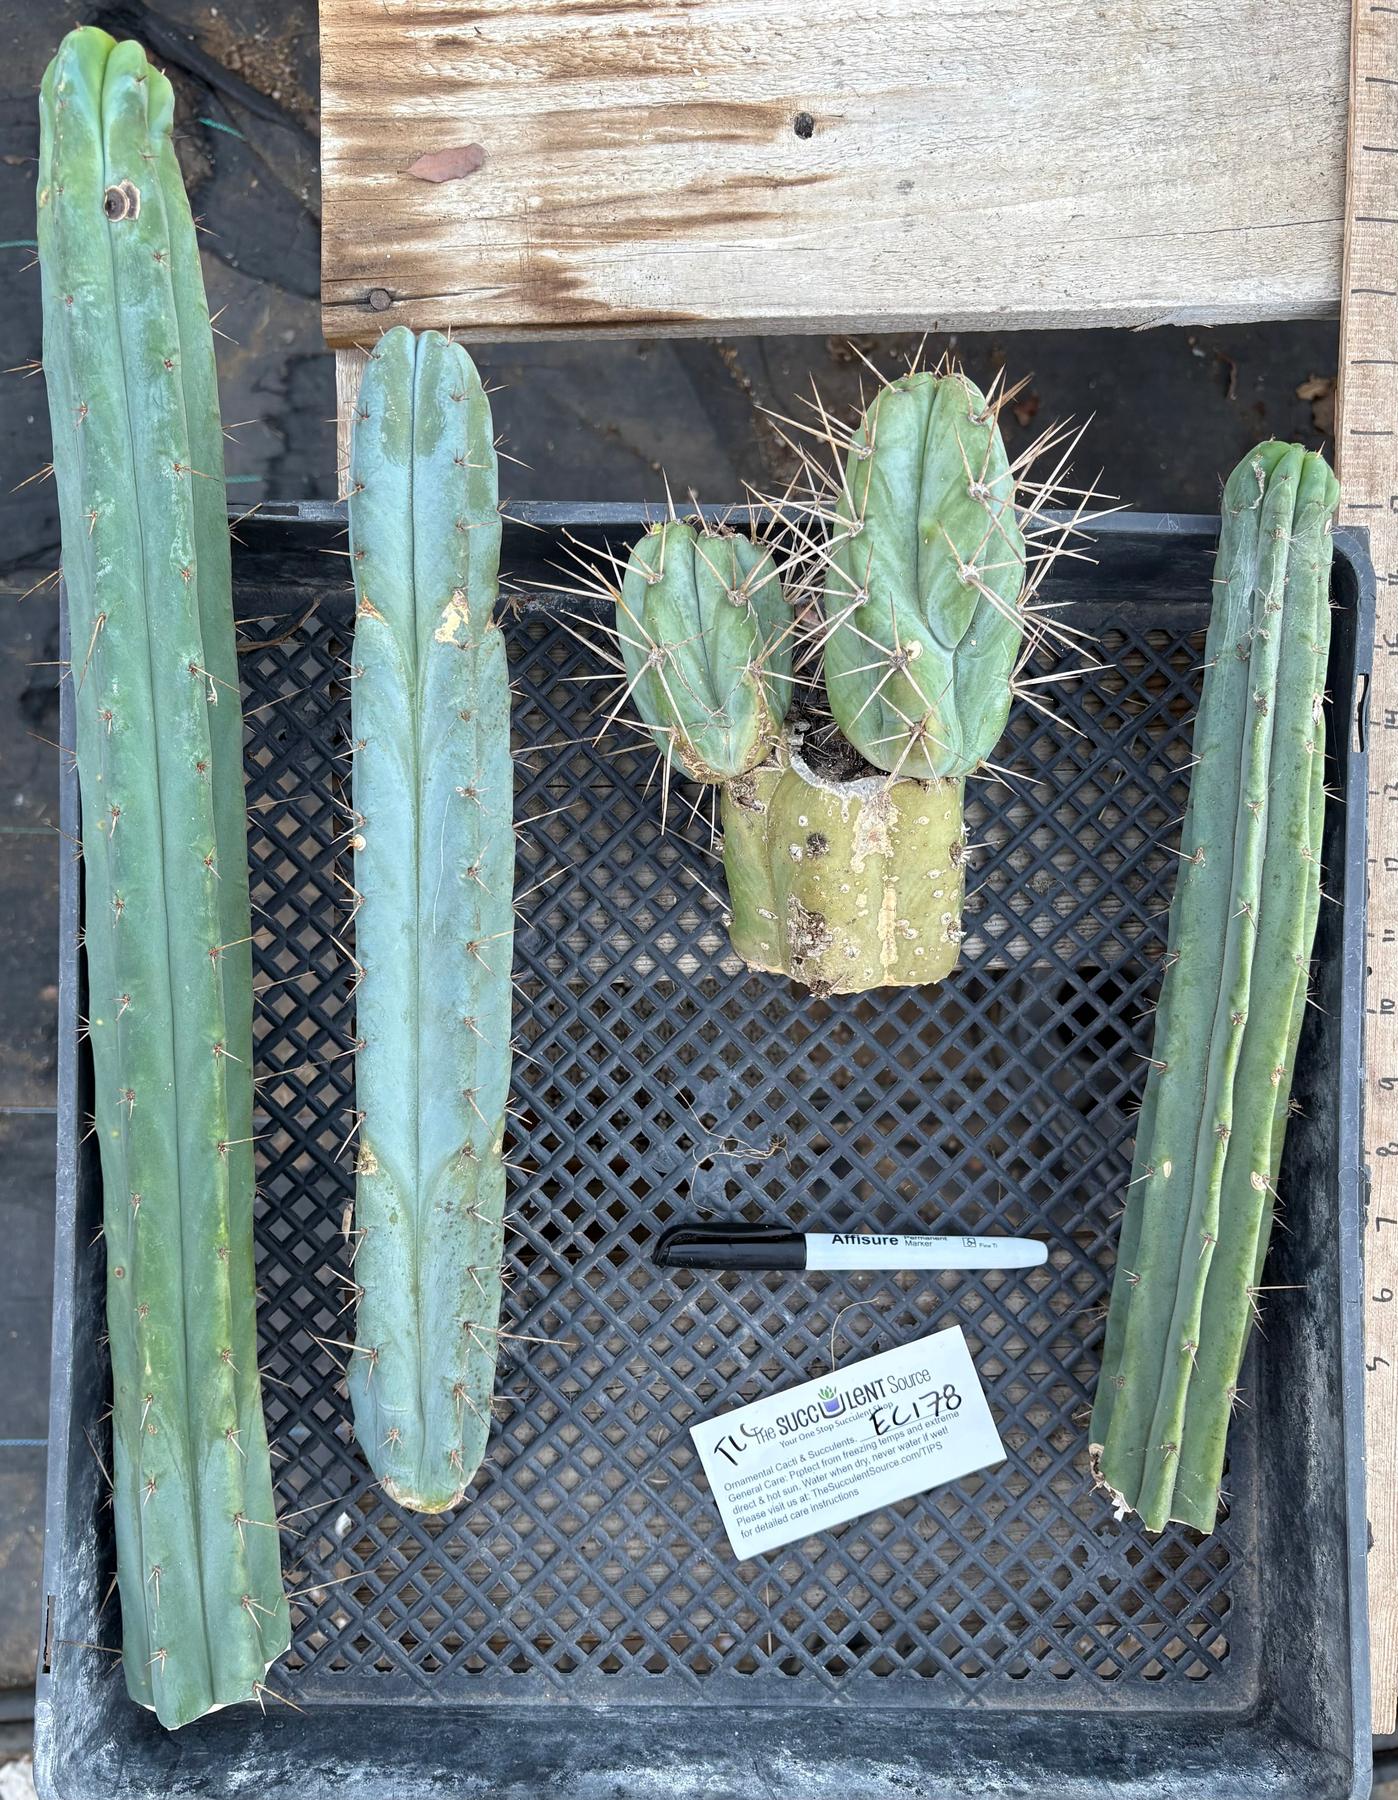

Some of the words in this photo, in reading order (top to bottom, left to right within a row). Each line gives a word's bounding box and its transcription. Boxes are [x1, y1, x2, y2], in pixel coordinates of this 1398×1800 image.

[1380, 998, 1395, 1014] 10
[832, 1234, 898, 1245] Affisure
[1375, 1216, 1397, 1232] 7
[1373, 1287, 1392, 1302] 6
[887, 1369, 931, 1393] Source
[779, 1438, 798, 1449] Your
[798, 1430, 815, 1441] One
[815, 1423, 834, 1435] Stop
[834, 1408, 873, 1427] Succulent
[873, 1400, 894, 1412] Shop
[724, 1466, 774, 1491] Ornamental
[775, 1457, 798, 1472] Cacti
[799, 1454, 807, 1463] &
[728, 1484, 763, 1502] General
[764, 1475, 787, 1489] Care:
[789, 1462, 821, 1480] Protect
[821, 1454, 842, 1467] from
[842, 1440, 878, 1460] freezing
[879, 1430, 906, 1446] temps
[907, 1422, 923, 1435] and
[925, 1410, 960, 1428] extreme
[732, 1499, 758, 1515] direct
[758, 1496, 765, 1505] &
[766, 1490, 782, 1503] hot
[782, 1484, 802, 1495] sun.
[802, 1472, 828, 1488] Water
[829, 1461, 853, 1477] when
[872, 1447, 896, 1462] never
[897, 1438, 921, 1452] water
[922, 1432, 930, 1442] if
[930, 1425, 949, 1439] wet!
[736, 1509, 766, 1527] Please
[767, 1502, 785, 1515] visit
[787, 1498, 798, 1508] us
[811, 1440, 943, 1498] TheSucculentSource.com/TIPS
[740, 1527, 754, 1539] for
[754, 1515, 790, 1534] detailed
[790, 1509, 810, 1520] care
[810, 1487, 859, 1512] instructions
